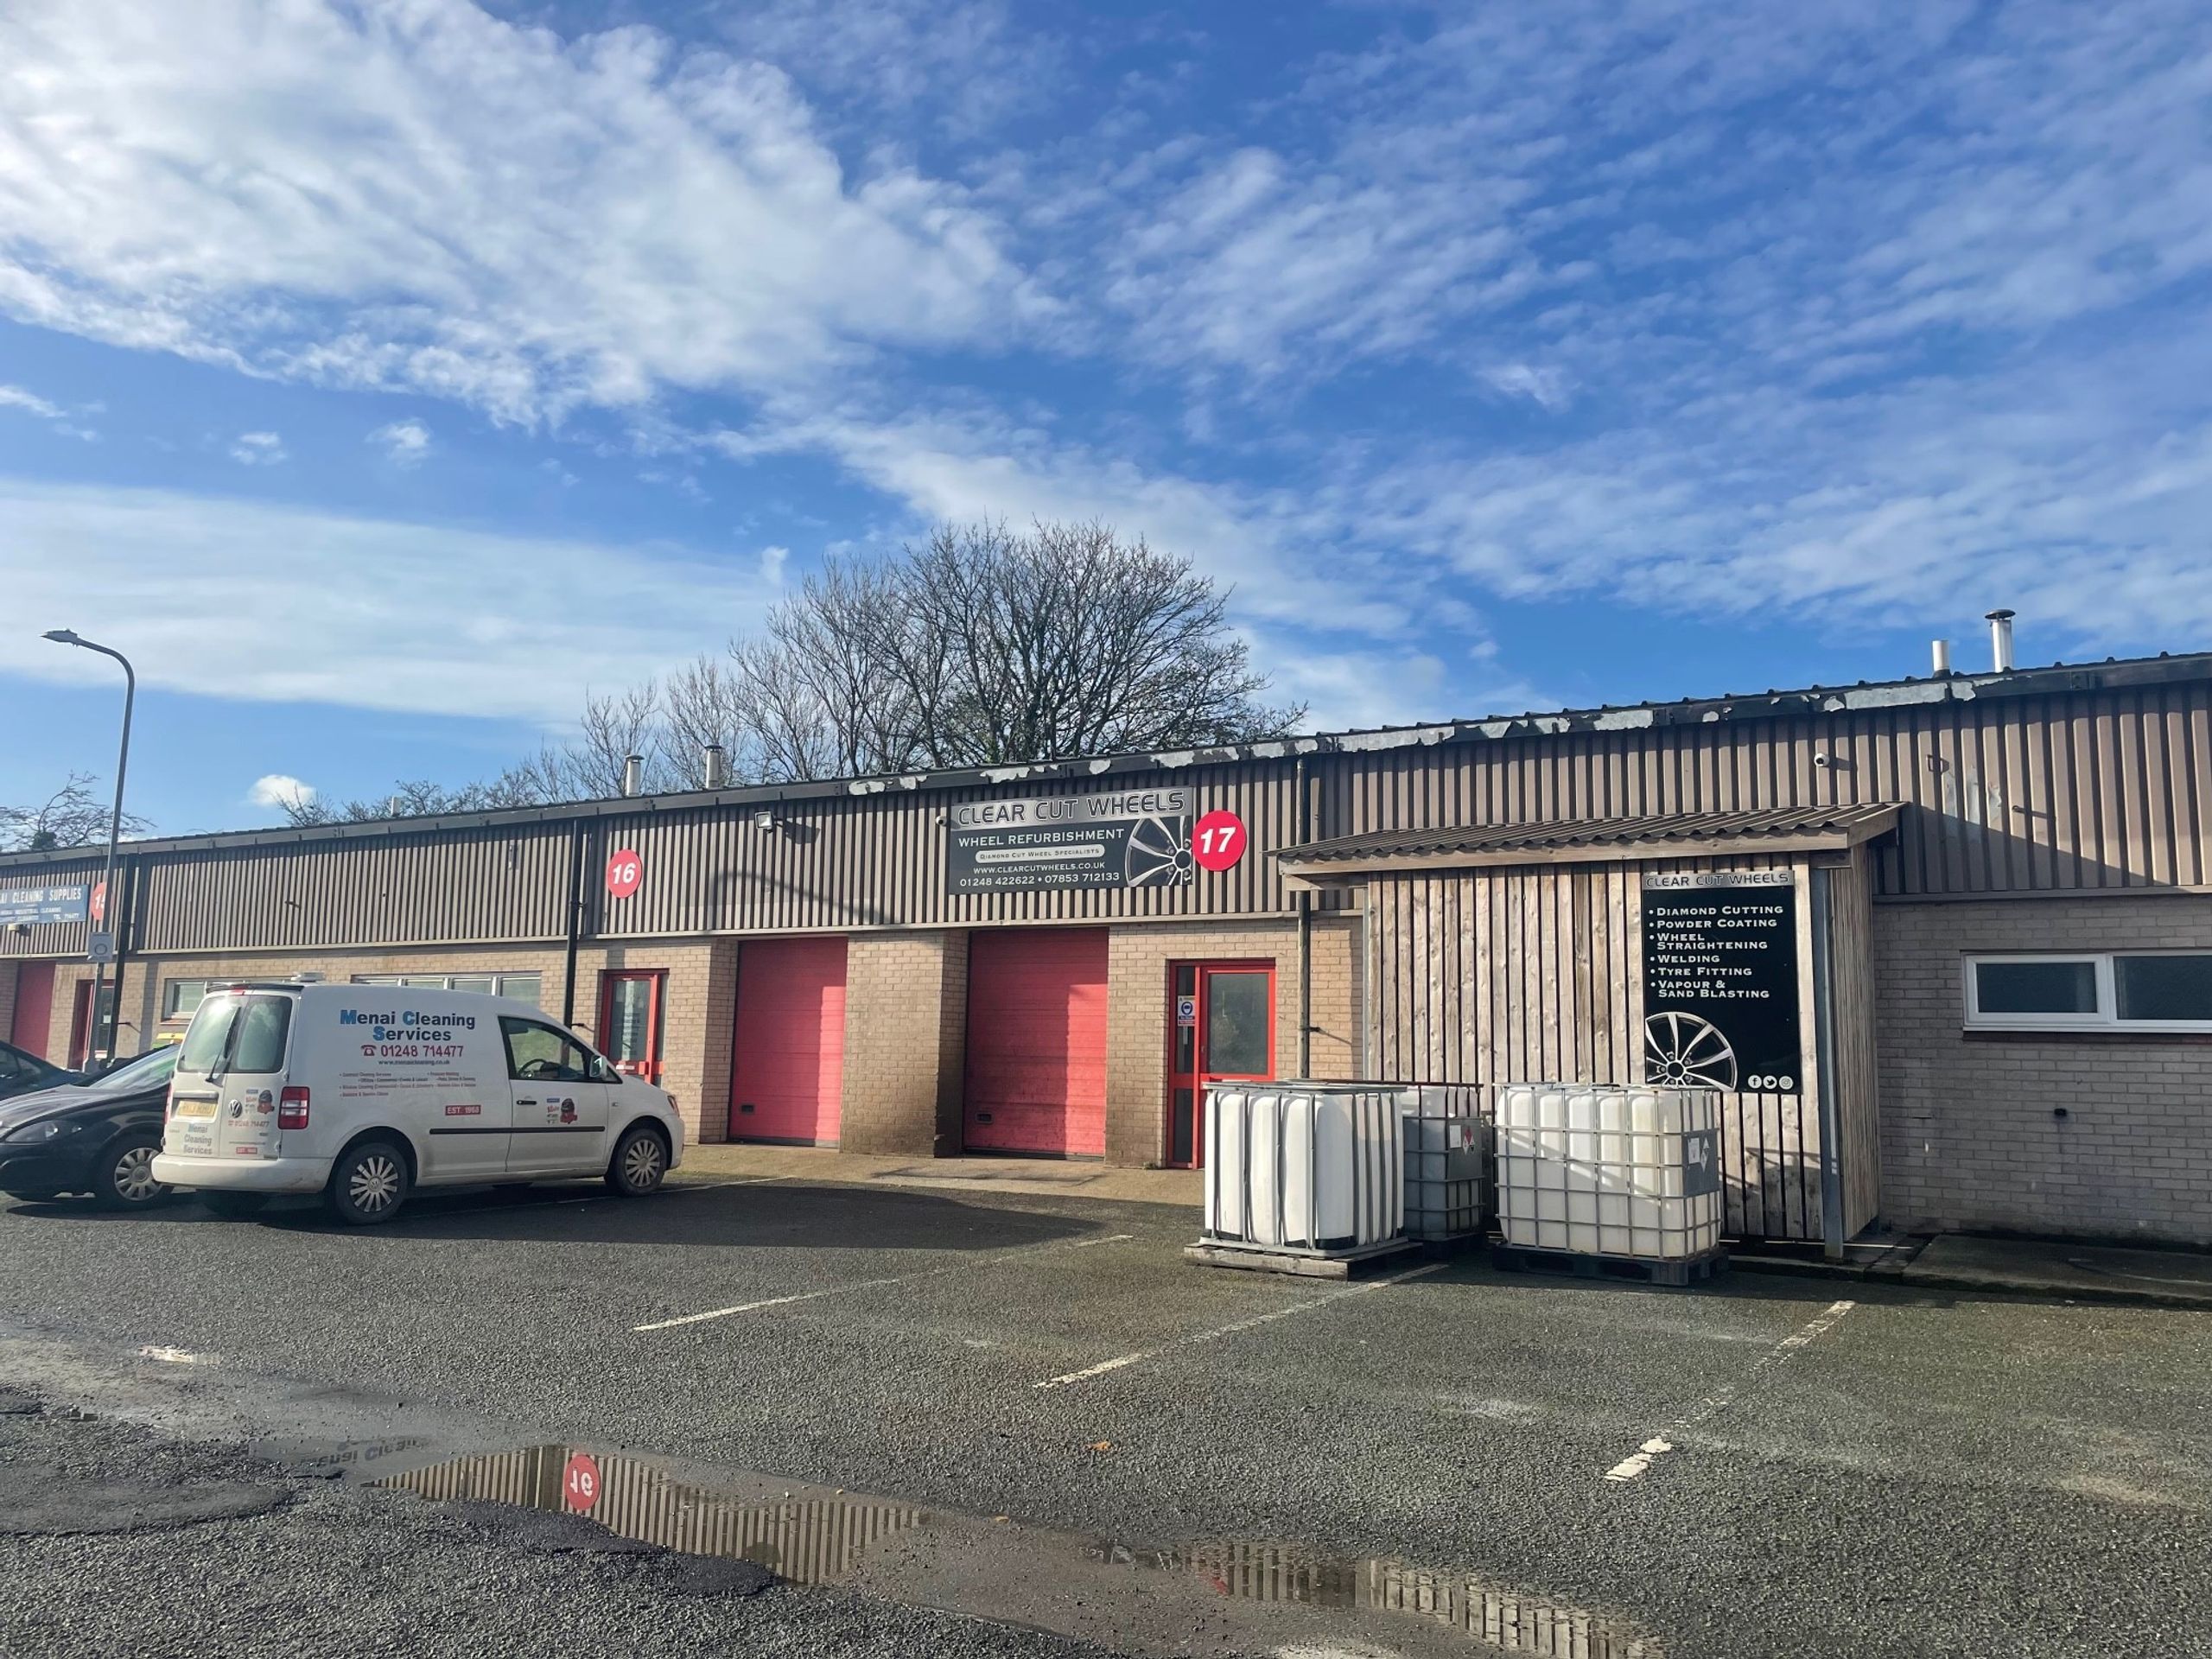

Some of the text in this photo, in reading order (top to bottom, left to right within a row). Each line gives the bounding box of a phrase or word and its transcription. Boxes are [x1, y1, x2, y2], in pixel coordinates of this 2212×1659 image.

[958, 790, 1185, 826] CLEAR CUT WHEELS
[958, 828, 1125, 848] WHEEL REFURBISHMENT
[1200, 826, 1236, 854] 17
[1054, 848, 1100, 856] SPECIALISTS
[613, 862, 637, 885] 16
[973, 861, 1106, 874] WWW.CLEARCUTWHEELS.CO.UK
[960, 872, 1120, 887] 01248 422622 07853 712133
[1646, 873, 1789, 887] CLEAR CUT WHEELS
[12, 890, 44, 904] CLEANING
[49, 887, 82, 901] SUPPLIES
[1656, 906, 1783, 916] DIAMOND CUTTING
[1656, 918, 1777, 929] POWDER COATING
[1656, 932, 1706, 942] WHEEL
[1656, 941, 1768, 950] STRAIGHTENING
[1657, 954, 1720, 963] WELDING
[1658, 967, 1752, 976] TYRE FITTING
[1658, 980, 1726, 989] VAPOUR &
[1658, 988, 1770, 999] SAND BLASTING
[340, 1009, 476, 1030] Menai Cleaning
[372, 1026, 452, 1041] Services
[381, 1045, 464, 1058] 01248 714477
[184, 1133, 213, 1146] Cleaning
[183, 1145, 213, 1155] Services
